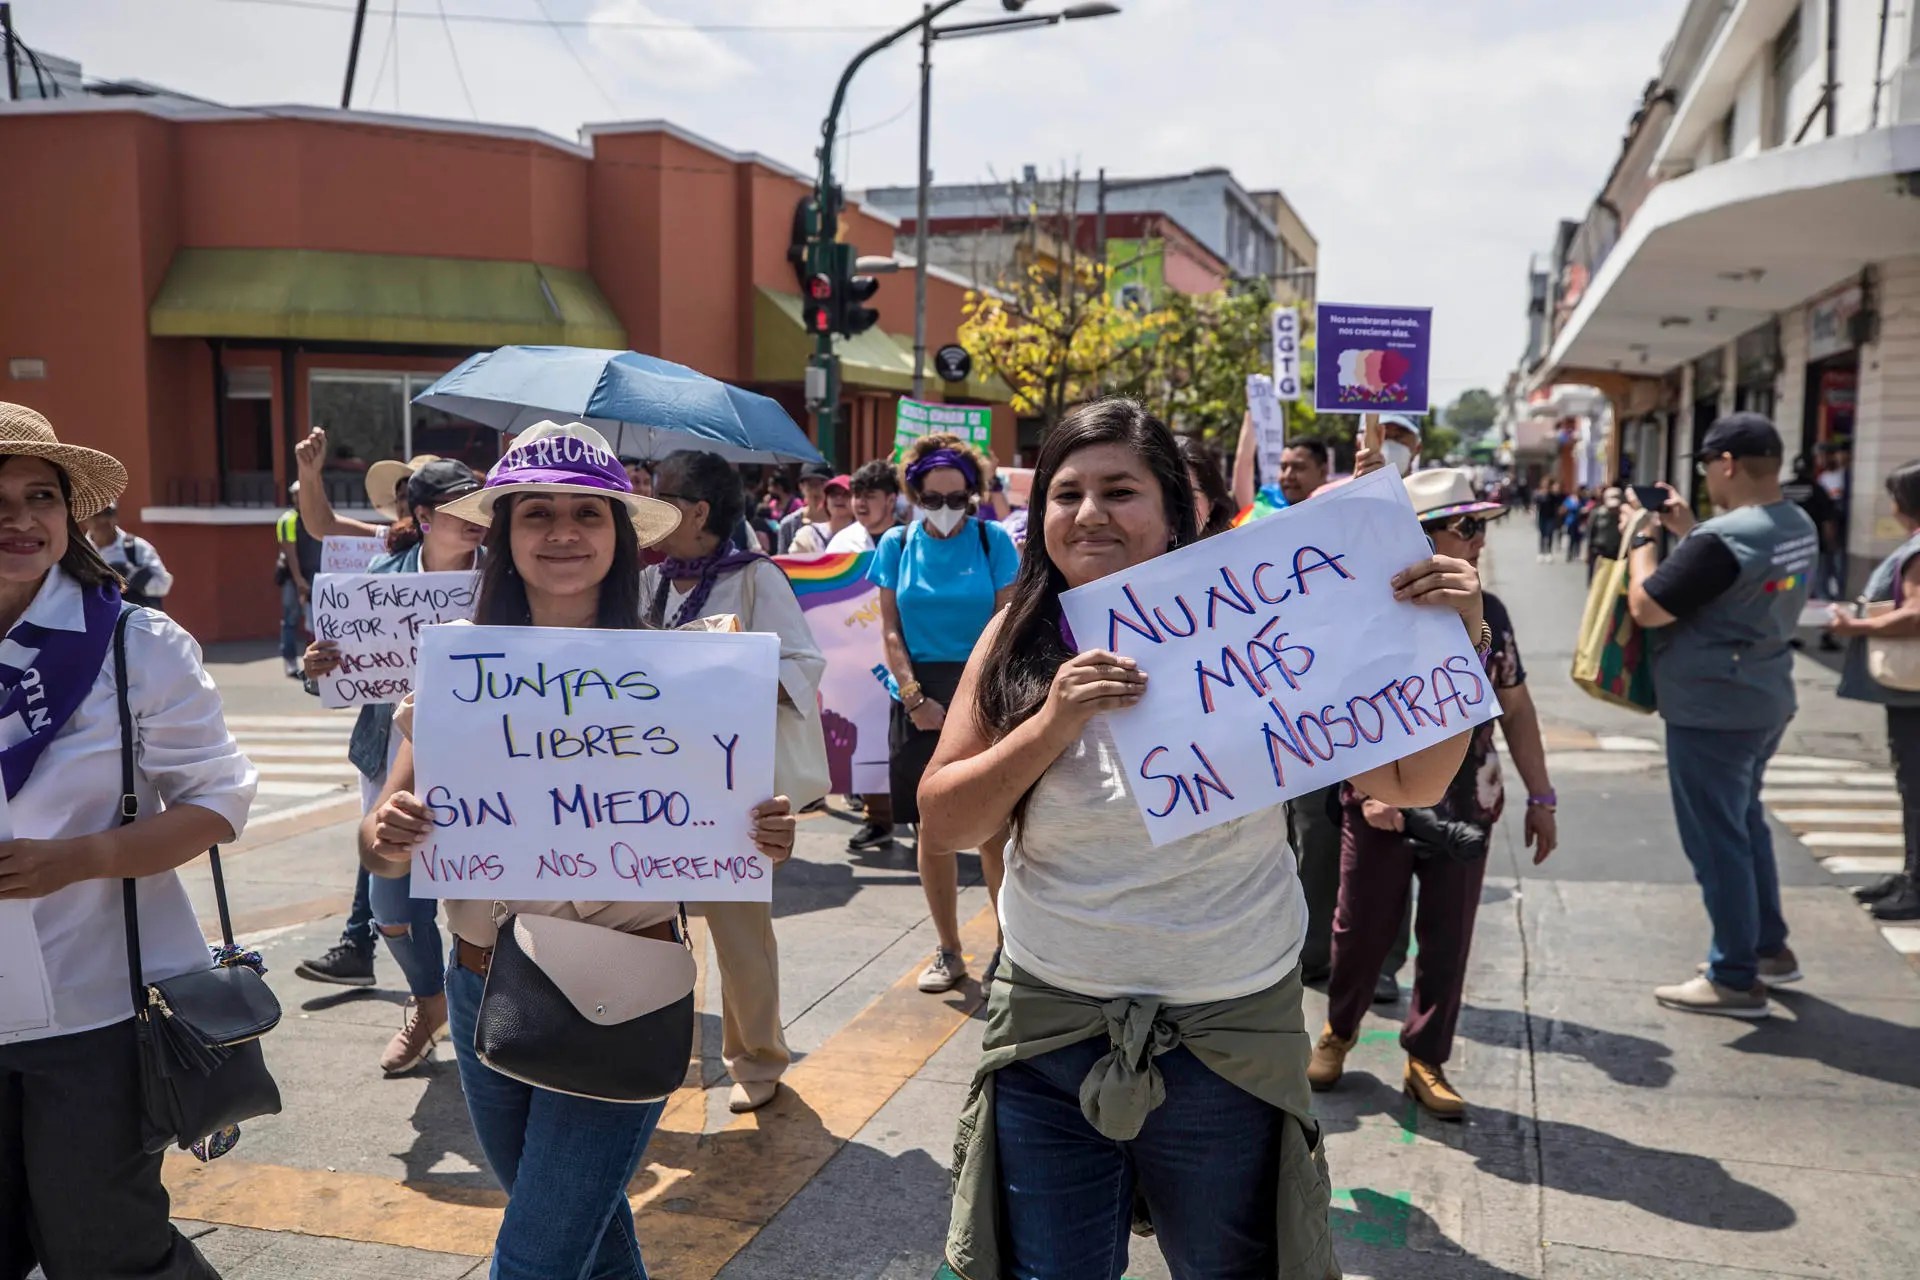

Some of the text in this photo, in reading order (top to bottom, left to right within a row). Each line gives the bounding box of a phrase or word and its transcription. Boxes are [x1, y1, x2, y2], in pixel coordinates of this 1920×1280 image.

[1277, 315, 1297, 395] CGTG
[319, 580, 474, 611] NO TENEMOS
[1107, 545, 1357, 653] NUNCA
[449, 652, 661, 716] JUNTAS
[1194, 615, 1316, 715] MÁS
[502, 713, 739, 790] LIBRES Y
[1140, 655, 1486, 819] SIN NOSOTRAS
[426, 783, 716, 829] SIN MIEDO...
[419, 841, 764, 888] VIVAS NOS QUEREMOS
